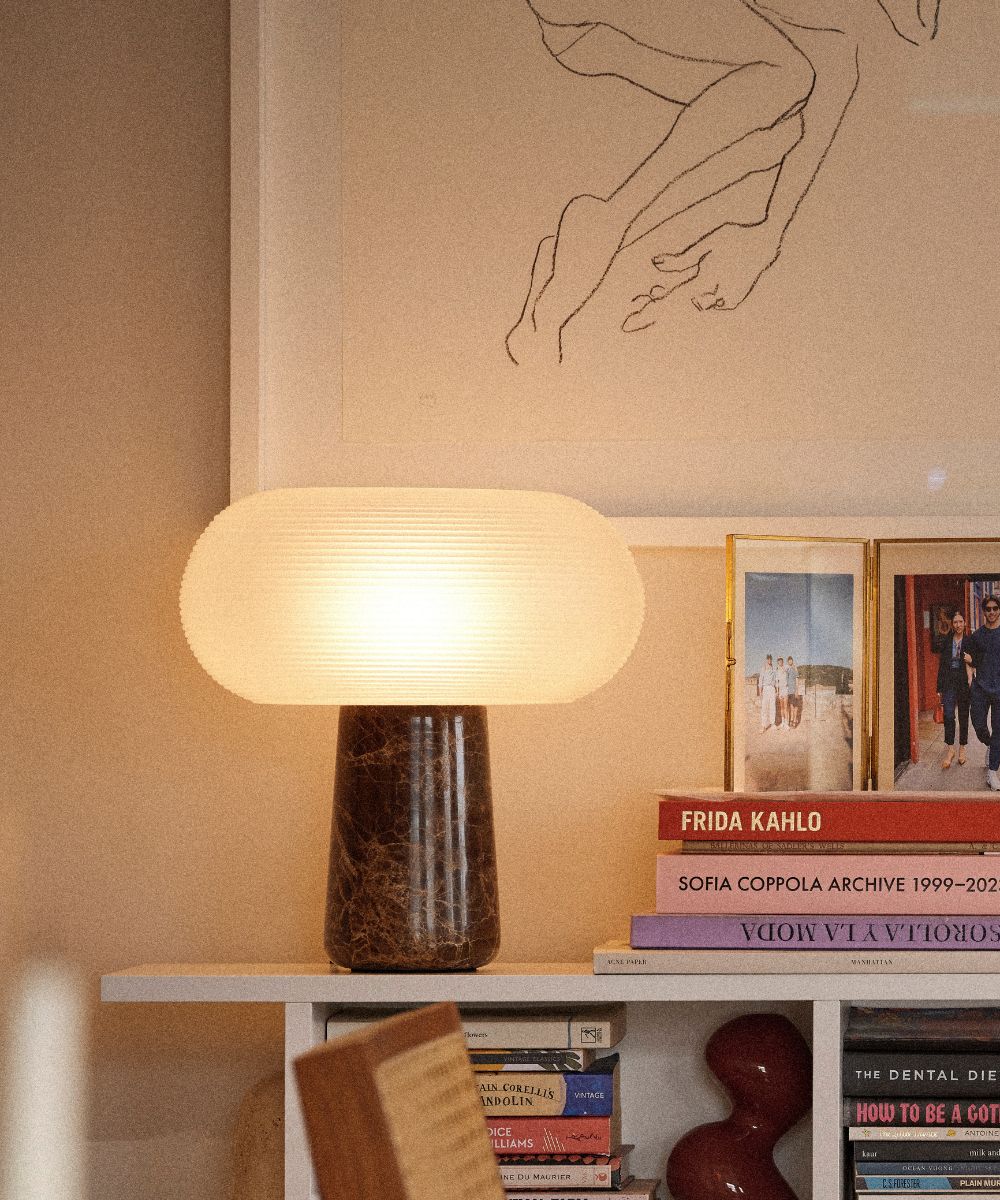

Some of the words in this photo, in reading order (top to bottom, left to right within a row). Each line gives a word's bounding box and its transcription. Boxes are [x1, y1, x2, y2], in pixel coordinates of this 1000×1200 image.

[681, 810, 743, 831] FRIDA
[751, 810, 822, 832] KAHLO
[710, 841, 760, 850] BALLERINAS
[761, 842, 773, 850] OF
[777, 842, 816, 850] SADLER'S
[818, 842, 846, 850] WELLS
[679, 876, 732, 892] SOFIA
[738, 876, 824, 892] COPPOLA
[828, 877, 906, 892] ARCHIVE
[741, 922, 816, 942] MODA
[825, 923, 858, 942] LA
[863, 923, 879, 942] Y
[607, 958, 624, 966] ACNE
[626, 958, 647, 966] PAPER
[856, 1070, 881, 1079] THE
[889, 1069, 959, 1081] DENTAL
[502, 1083, 555, 1100] CORELLI'S
[856, 1103, 895, 1124] HOW
[899, 1103, 920, 1124] TO
[925, 1103, 946, 1124] BE
[951, 1103, 962, 1124] A
[862, 1150, 878, 1158] kaur
[960, 1179, 983, 1187] PLAIN
